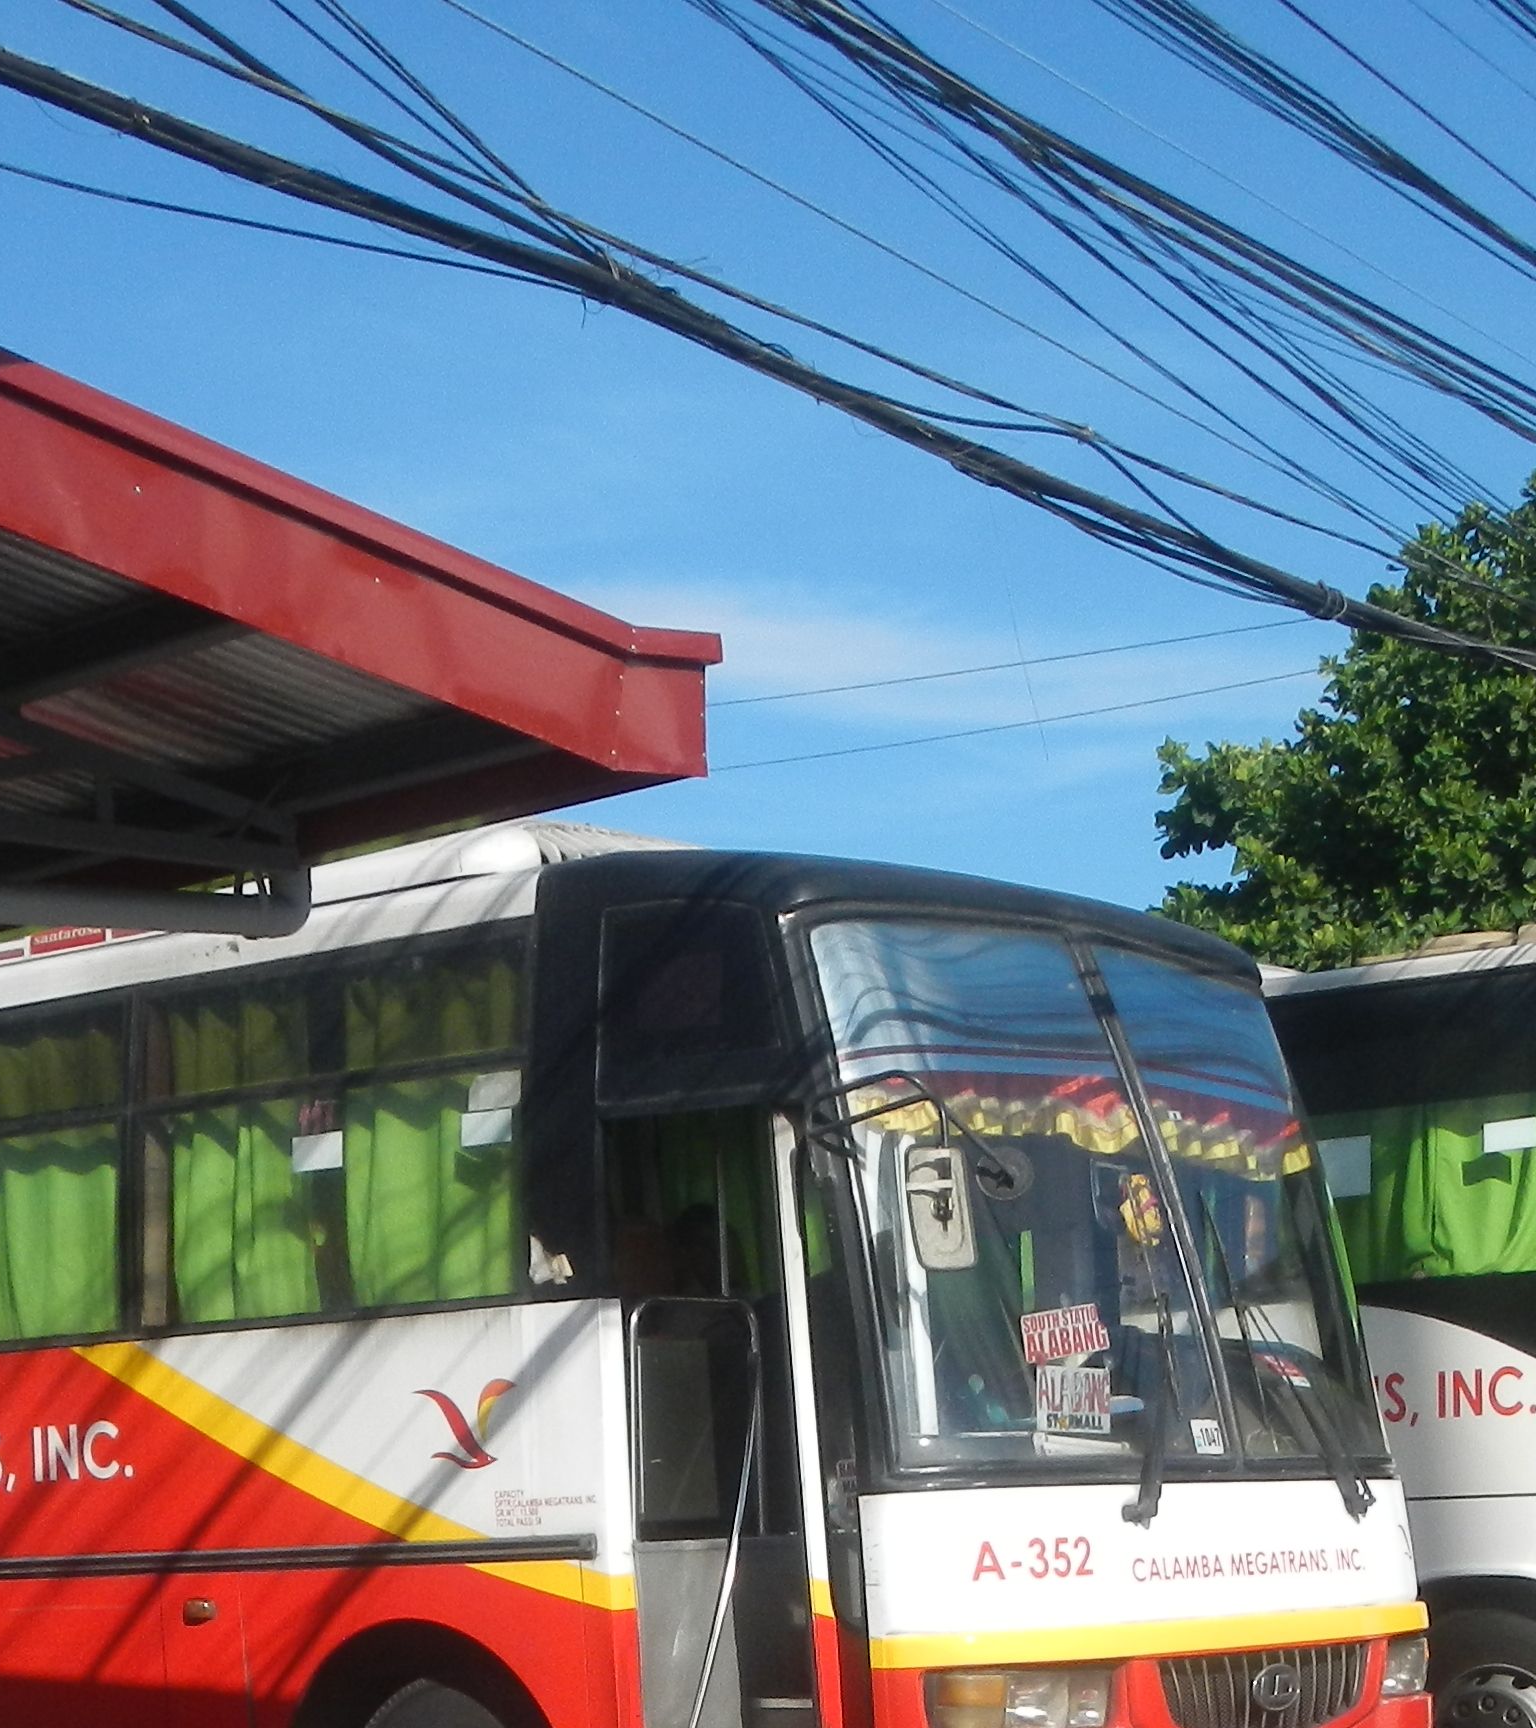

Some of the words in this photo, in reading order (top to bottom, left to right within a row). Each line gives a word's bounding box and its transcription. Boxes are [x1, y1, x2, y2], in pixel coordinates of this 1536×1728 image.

[1023, 1311, 1060, 1333] SOUTH
[1025, 1322, 1107, 1363] ALABANG
[1039, 1369, 1110, 1414] ALABANG
[33, 1419, 135, 1483] INC.
[972, 1536, 1094, 1582] A-352
[1132, 1554, 1224, 1582] CALAMBA
[1335, 1548, 1366, 1571] INC.
